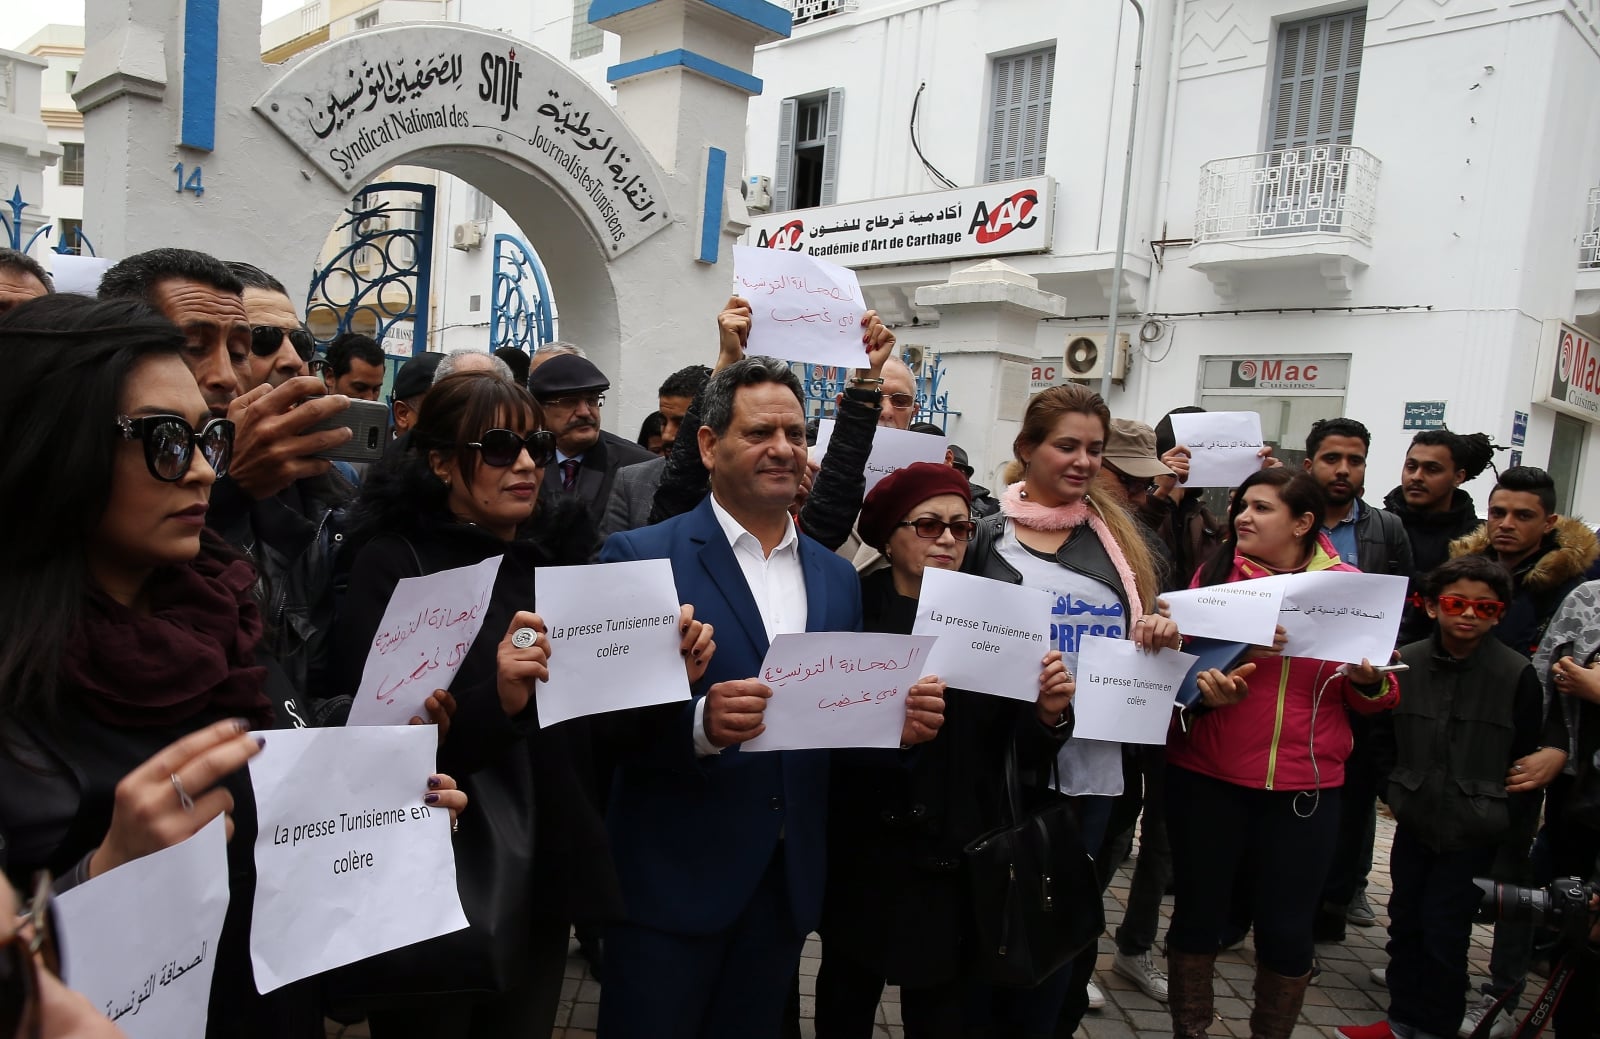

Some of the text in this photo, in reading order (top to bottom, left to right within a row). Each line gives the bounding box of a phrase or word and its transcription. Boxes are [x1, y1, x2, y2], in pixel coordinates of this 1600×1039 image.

[479, 48, 522, 121] snjt
[173, 161, 205, 197] 14
[329, 104, 626, 242] Syndicat National des Journalistes Tunisiens
[809, 201, 962, 238] أكادمية قرطاج للفنون
[808, 232, 962, 257] Académie d'Art de Carthage
[770, 306, 854, 333] في غضب
[1031, 366, 1055, 380] ac
[1261, 360, 1319, 381] Mac
[1568, 389, 1599, 412] Cuisines
[1043, 590, 1123, 617] صحاف
[1197, 595, 1227, 607] colère
[1208, 587, 1272, 599] unisienne en
[1304, 605, 1316, 616] في
[1317, 605, 1348, 617] التونسية
[1350, 607, 1384, 620] الصحافة
[552, 613, 675, 642] La presse Tunisienne en
[930, 610, 1043, 643] La presse Tunisienne en
[596, 643, 630, 659] colère
[971, 638, 1000, 655] colère
[839, 647, 919, 673] الصحافة
[1089, 673, 1172, 692] La presse Tunisienne en
[818, 686, 898, 712] في غضب
[1127, 696, 1147, 706] colère
[273, 804, 431, 847] La presse Tunisienne en
[333, 850, 374, 875] colère
[160, 940, 208, 987] الصحافة
[1530, 1002, 1550, 1026] EOS
